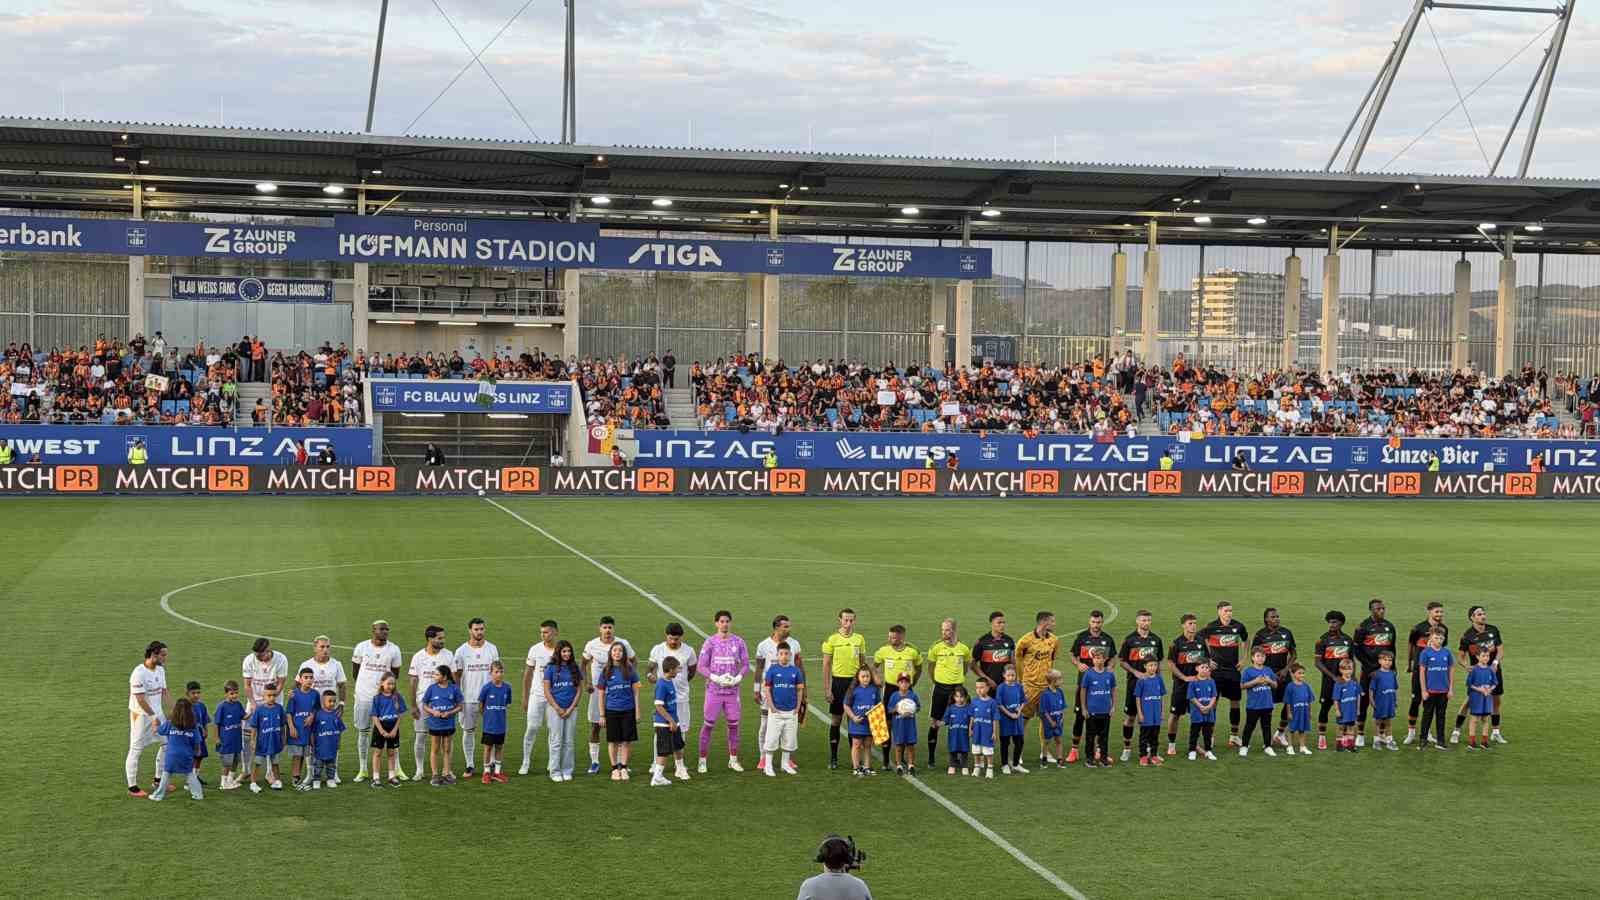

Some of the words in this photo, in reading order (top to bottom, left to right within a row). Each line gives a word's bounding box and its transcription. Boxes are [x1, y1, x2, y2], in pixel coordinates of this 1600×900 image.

[0, 222, 82, 247] erbank
[233, 228, 296, 243] ZAUNER
[414, 219, 467, 233] Personal
[233, 241, 288, 255] GROUP
[339, 233, 467, 259] HOFMANN
[475, 238, 595, 263] STADION
[628, 243, 722, 267] STIGA
[858, 248, 912, 261] ZAUNER
[857, 260, 904, 273] GROUP
[197, 281, 218, 295] WEISS
[219, 281, 236, 295] FANS
[267, 283, 287, 296] GEGEN
[403, 390, 422, 403] FC
[424, 391, 461, 403] BLAU
[463, 391, 508, 404] WSS
[509, 392, 541, 404] LINZ
[7, 439, 100, 455] IWEST
[171, 436, 264, 457] LINZ
[634, 440, 714, 459] LINZ
[1017, 443, 1094, 462] LINZ
[1101, 444, 1149, 462] AG
[1285, 446, 1333, 464] AG
[1381, 444, 1434, 464] Linze
[1441, 444, 1479, 465] Bier
[0, 467, 54, 490] TCH
[63, 469, 93, 488] PR
[115, 467, 206, 489] MATCH
[215, 469, 244, 488] PR
[267, 468, 355, 490] MATCH
[363, 470, 390, 488] PR
[415, 468, 500, 491] MATCH
[507, 470, 537, 488] PR
[554, 469, 636, 490] MATCH
[643, 471, 670, 489] PR
[689, 470, 769, 491] MATCH
[775, 472, 801, 489] PR
[823, 471, 900, 491] MATCH
[907, 472, 932, 489] PR
[948, 471, 1024, 491] MATCH
[1030, 473, 1055, 489] PR
[1073, 471, 1147, 492] MATCH
[1153, 473, 1177, 490] PR
[1198, 472, 1271, 493] MATCH
[1276, 474, 1300, 491] PR
[1316, 473, 1388, 493] MATCH
[1393, 475, 1416, 492] PR
[1434, 474, 1505, 494] MATCH
[1510, 475, 1533, 491] PR
